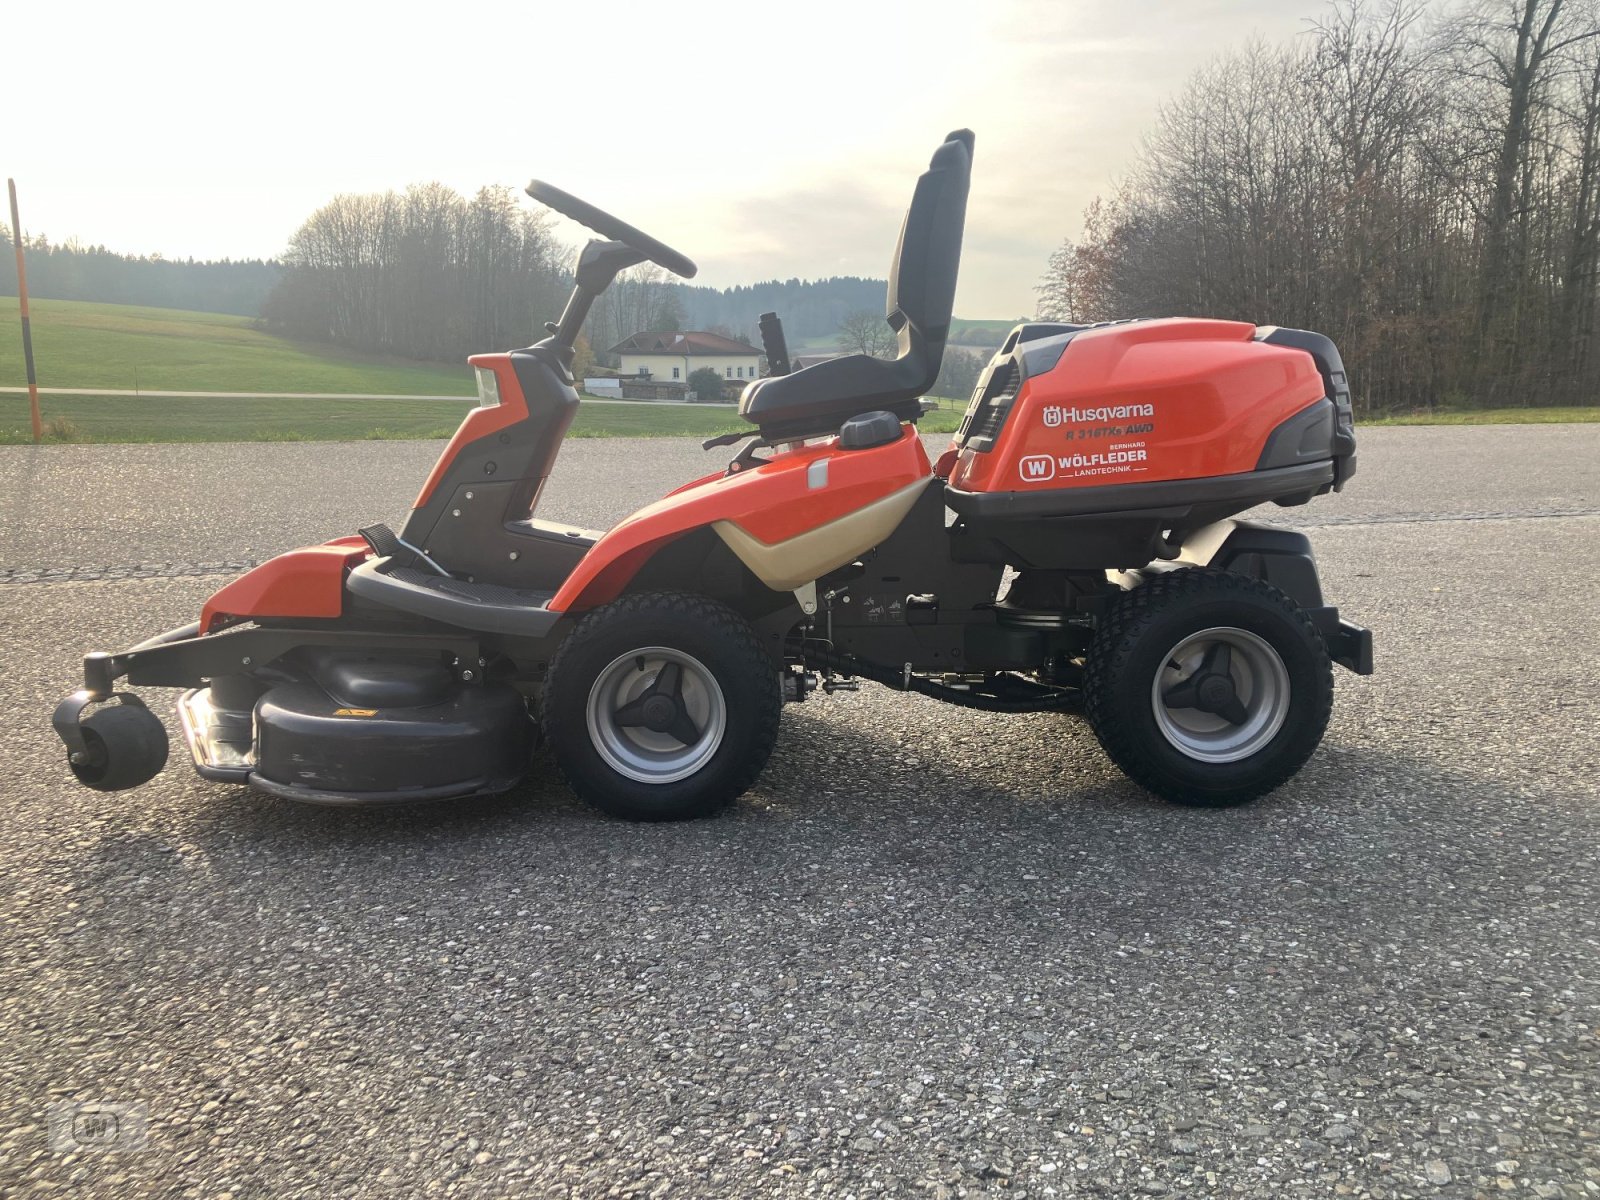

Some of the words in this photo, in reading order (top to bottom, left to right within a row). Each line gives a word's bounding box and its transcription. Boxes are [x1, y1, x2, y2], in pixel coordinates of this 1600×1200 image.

[1063, 403, 1154, 423] Husqvarna
[1066, 431, 1074, 440] R
[1126, 423, 1154, 435] AWD
[1110, 441, 1146, 450] BERNHARD
[1058, 450, 1147, 469] WÖLFLEDER
[1028, 461, 1046, 476] W
[1074, 465, 1132, 477] LANDTECHNIK
